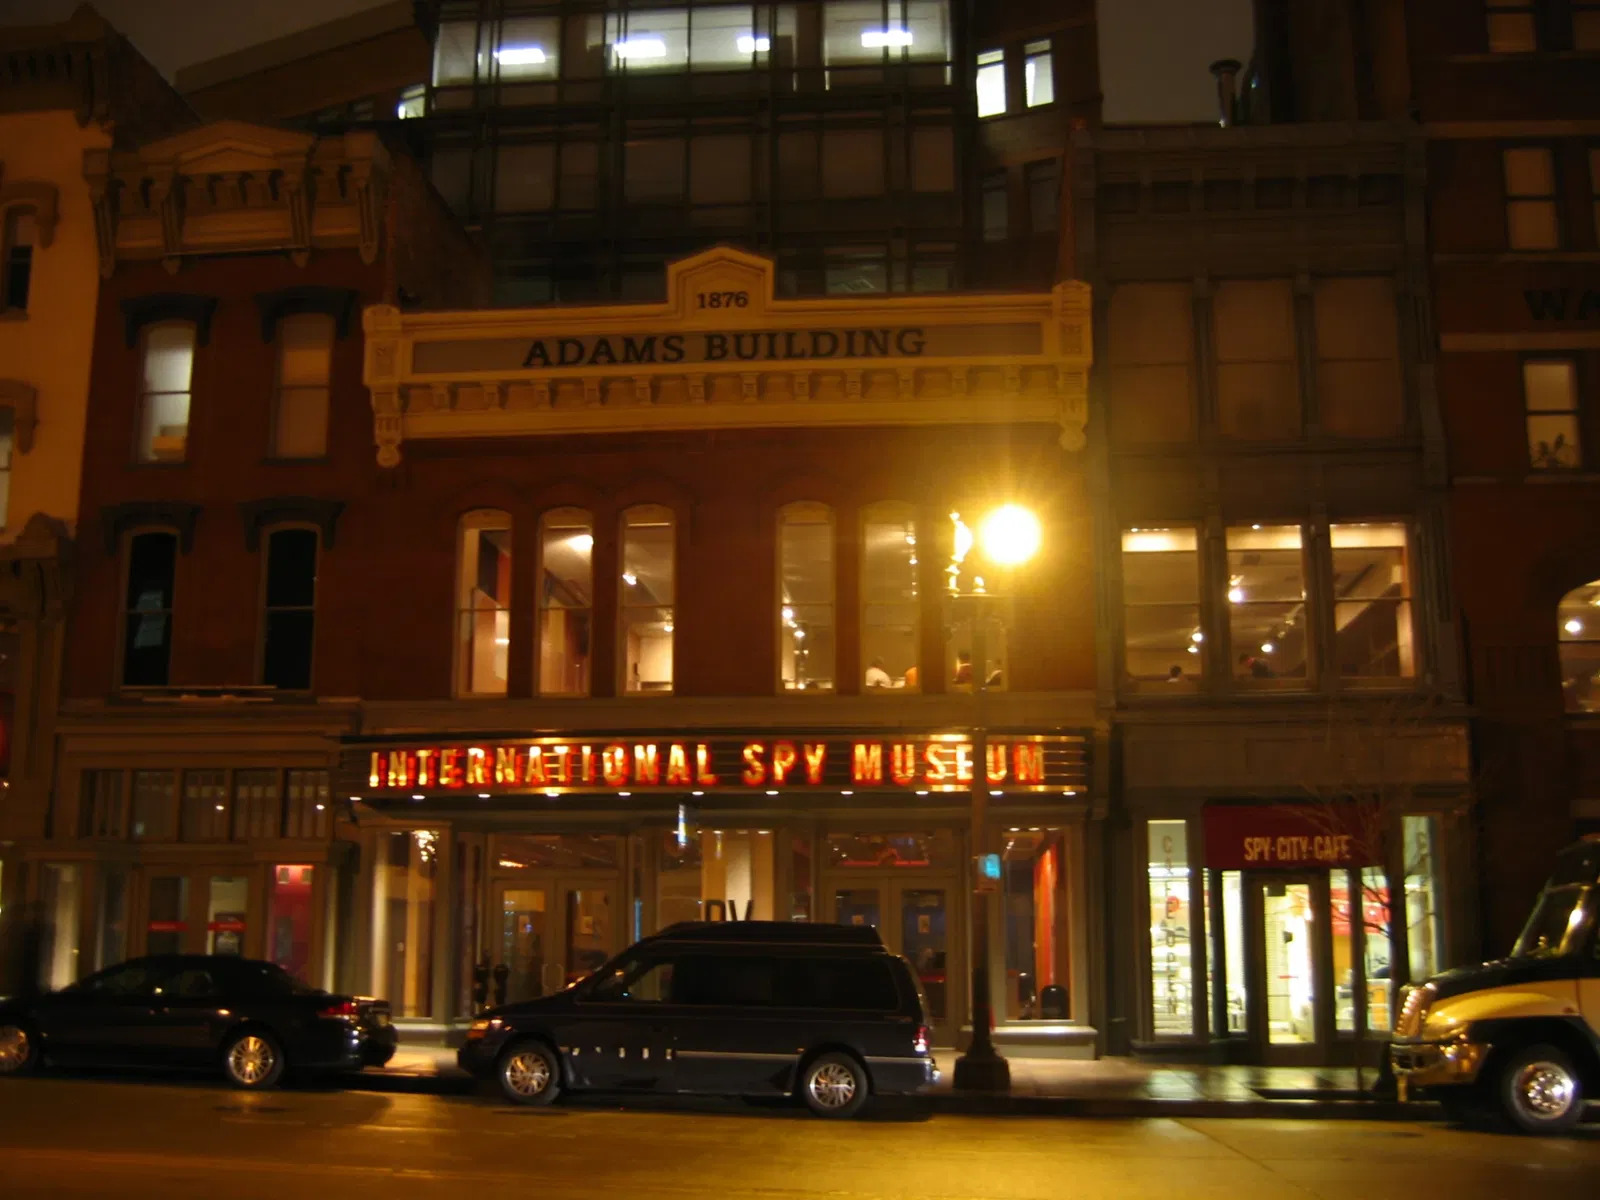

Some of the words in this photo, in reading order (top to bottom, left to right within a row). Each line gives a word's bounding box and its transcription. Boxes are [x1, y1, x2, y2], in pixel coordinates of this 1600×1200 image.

[697, 291, 749, 309] 1876
[522, 333, 685, 367] ADAMS
[703, 327, 926, 360] BUILDING
[368, 743, 717, 788] INTERNATIONAL
[742, 741, 827, 785] SPY
[852, 741, 1046, 785] MUSEUM
